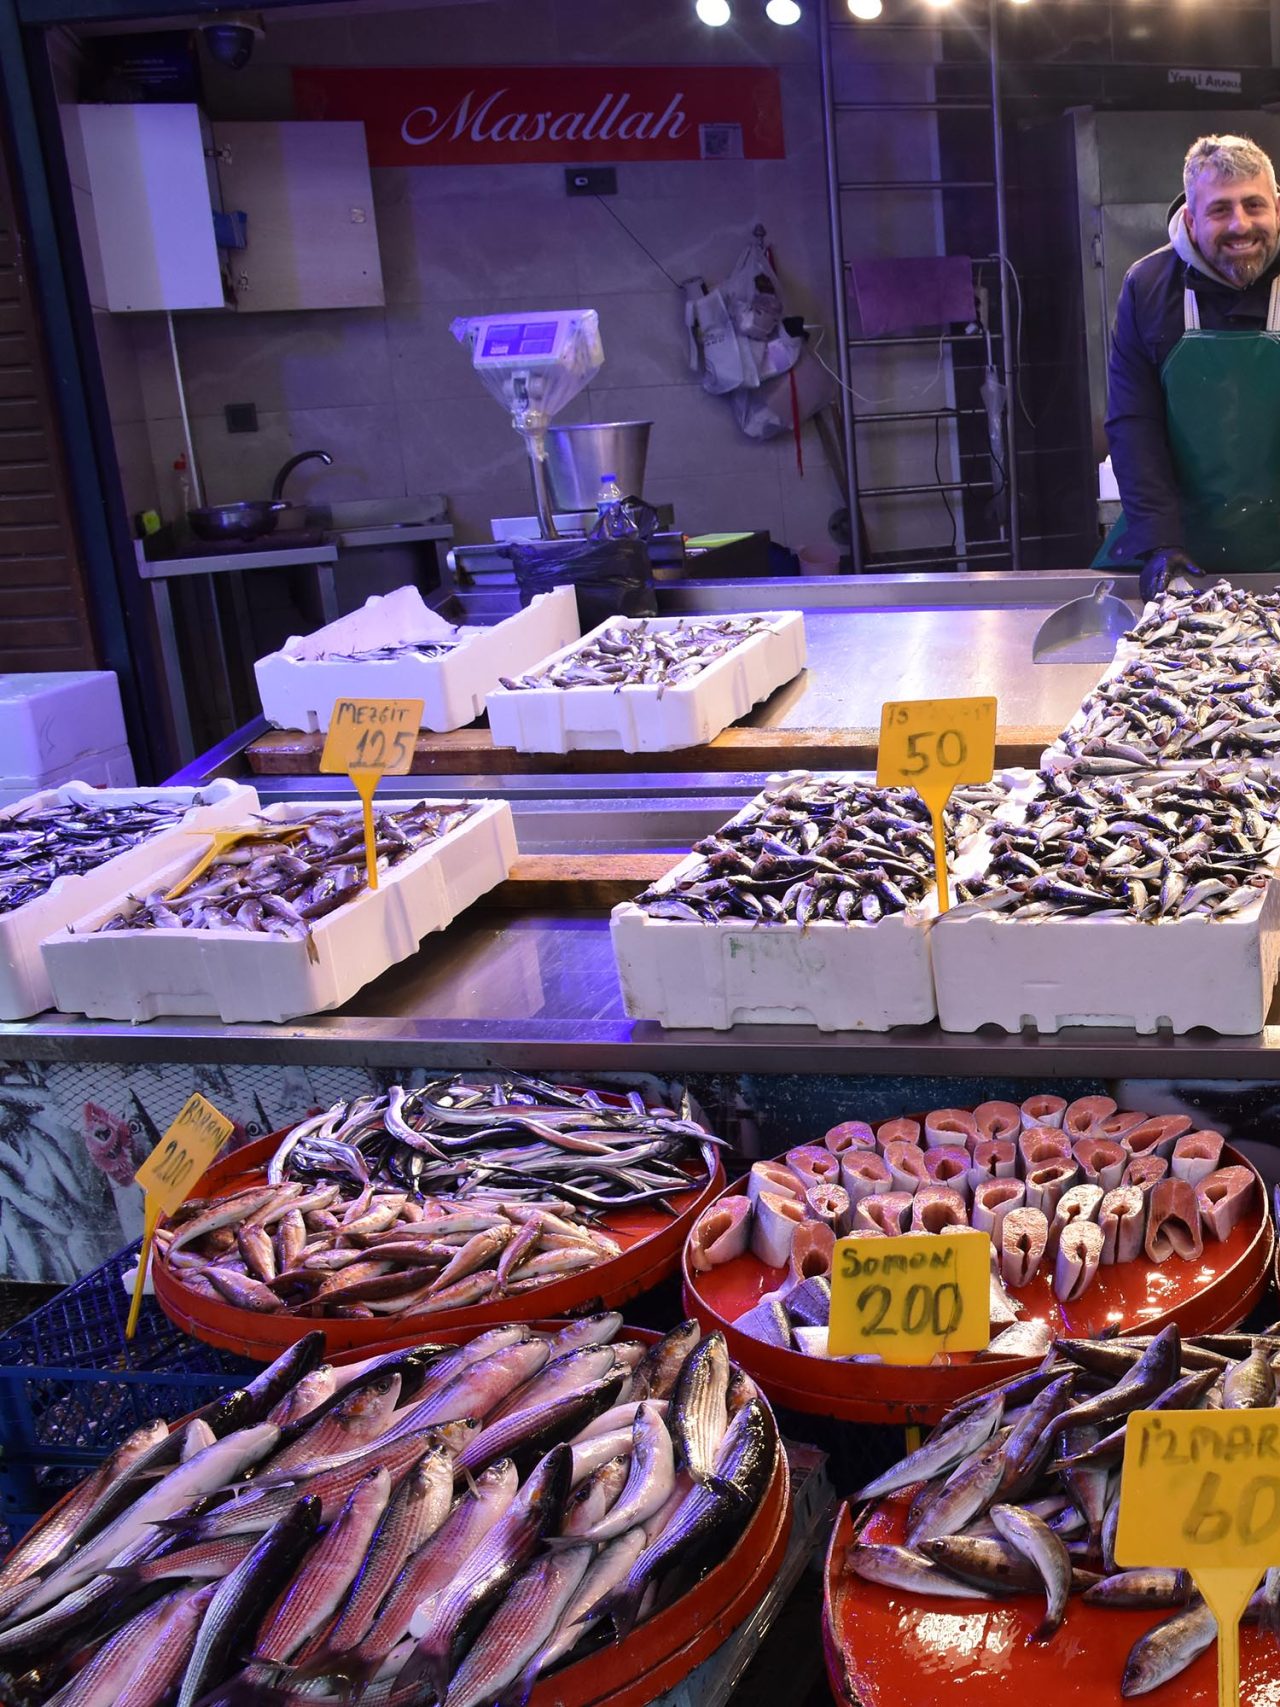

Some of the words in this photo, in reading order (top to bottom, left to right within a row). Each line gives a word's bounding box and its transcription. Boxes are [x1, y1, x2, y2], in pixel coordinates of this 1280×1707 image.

[401, 88, 691, 145] Masallah
[348, 729, 415, 768] 125
[898, 729, 968, 776] 50
[152, 1140, 194, 1190] 200
[842, 1247, 953, 1278] SOMON
[856, 1282, 964, 1337] 200
